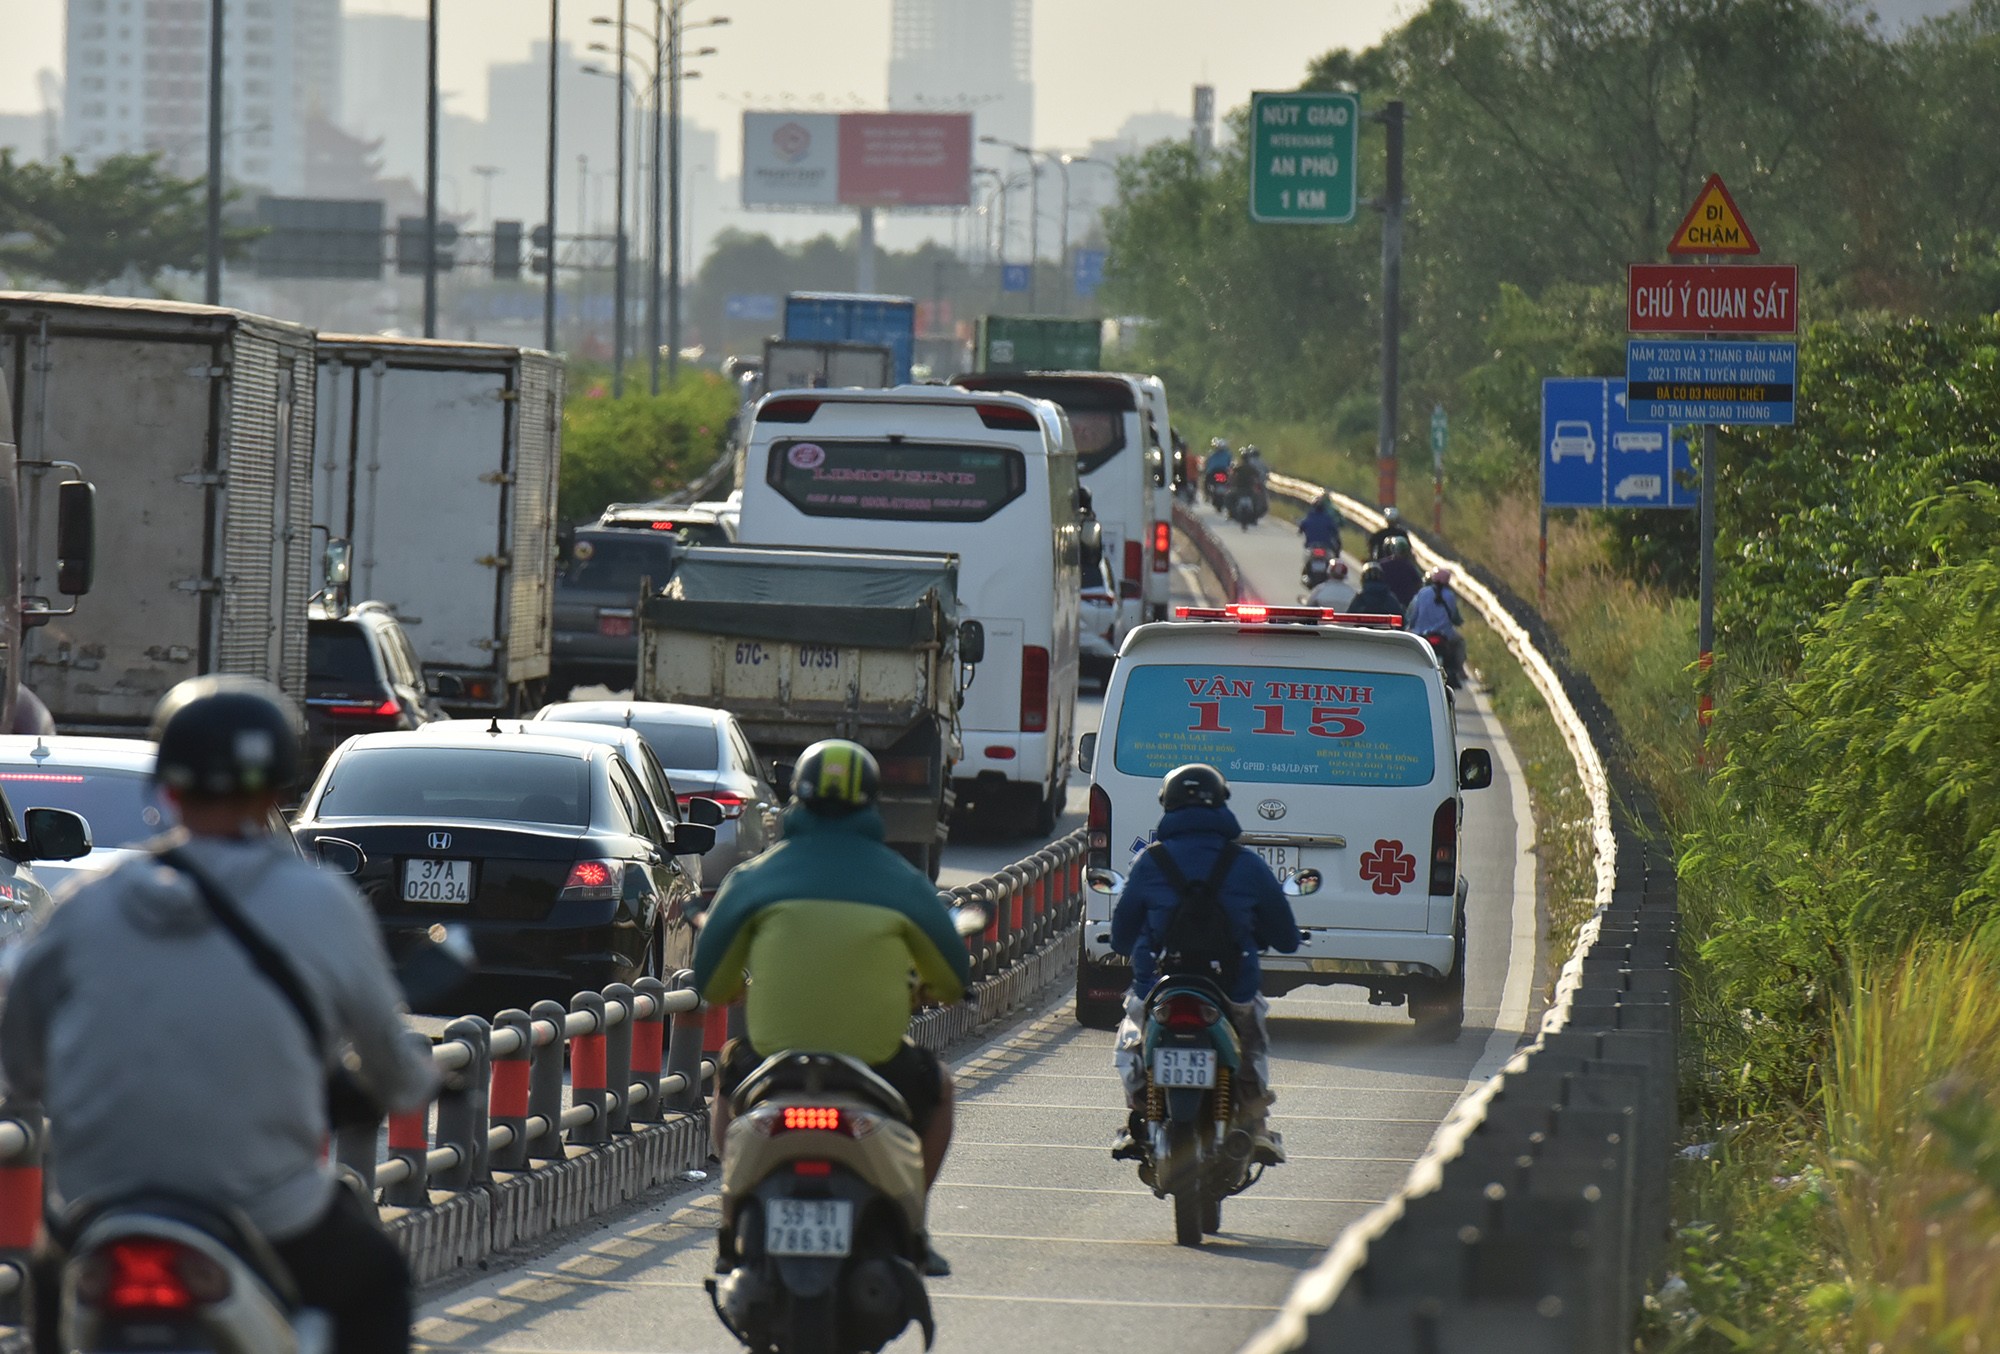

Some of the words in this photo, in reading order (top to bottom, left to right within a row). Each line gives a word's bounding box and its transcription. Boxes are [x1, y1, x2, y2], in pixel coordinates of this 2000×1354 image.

[1263, 102, 1300, 125] NÚT
[1307, 106, 1348, 126] GIAO
[1270, 156, 1296, 176] AN
[1301, 153, 1339, 176] PHÚ
[1281, 190, 1290, 210] 1
[1297, 190, 1327, 210] KM
[1706, 205, 1724, 221] ĐI
[1688, 224, 1739, 247] CHẬM
[1636, 279, 1674, 318] CHÚ
[1680, 280, 1692, 318] Ý
[1697, 287, 1747, 319] QUAN
[1753, 281, 1789, 319] SÁT
[1631, 345, 1655, 362] NĂM
[1658, 348, 1681, 362] 2020
[1683, 345, 1697, 362] VÀ
[1700, 348, 1706, 363] 3
[1708, 347, 1742, 363] THÁNG
[1769, 347, 1792, 363] NĂM
[1647, 367, 1670, 381] 2021
[1674, 365, 1701, 381] TRÊN
[1704, 364, 1737, 381] TUYẾN
[1689, 386, 1701, 400] 03
[1651, 404, 1665, 418] DO
[1668, 404, 1681, 418] TAI
[1709, 405, 1733, 419] GIAO
[1736, 404, 1770, 419] THÔNG
[813, 467, 976, 485] LIMOUSINE
[800, 644, 839, 669] 07351
[1184, 675, 1254, 700] VẬN
[1265, 682, 1374, 706] THỊNH
[1187, 702, 1366, 738] 115
[1230, 758, 1242, 770] SỐ
[1257, 847, 1286, 865] 51B
[422, 861, 454, 880] 37A
[408, 881, 466, 901] 020.34
[1163, 1069, 1207, 1085] 8030
